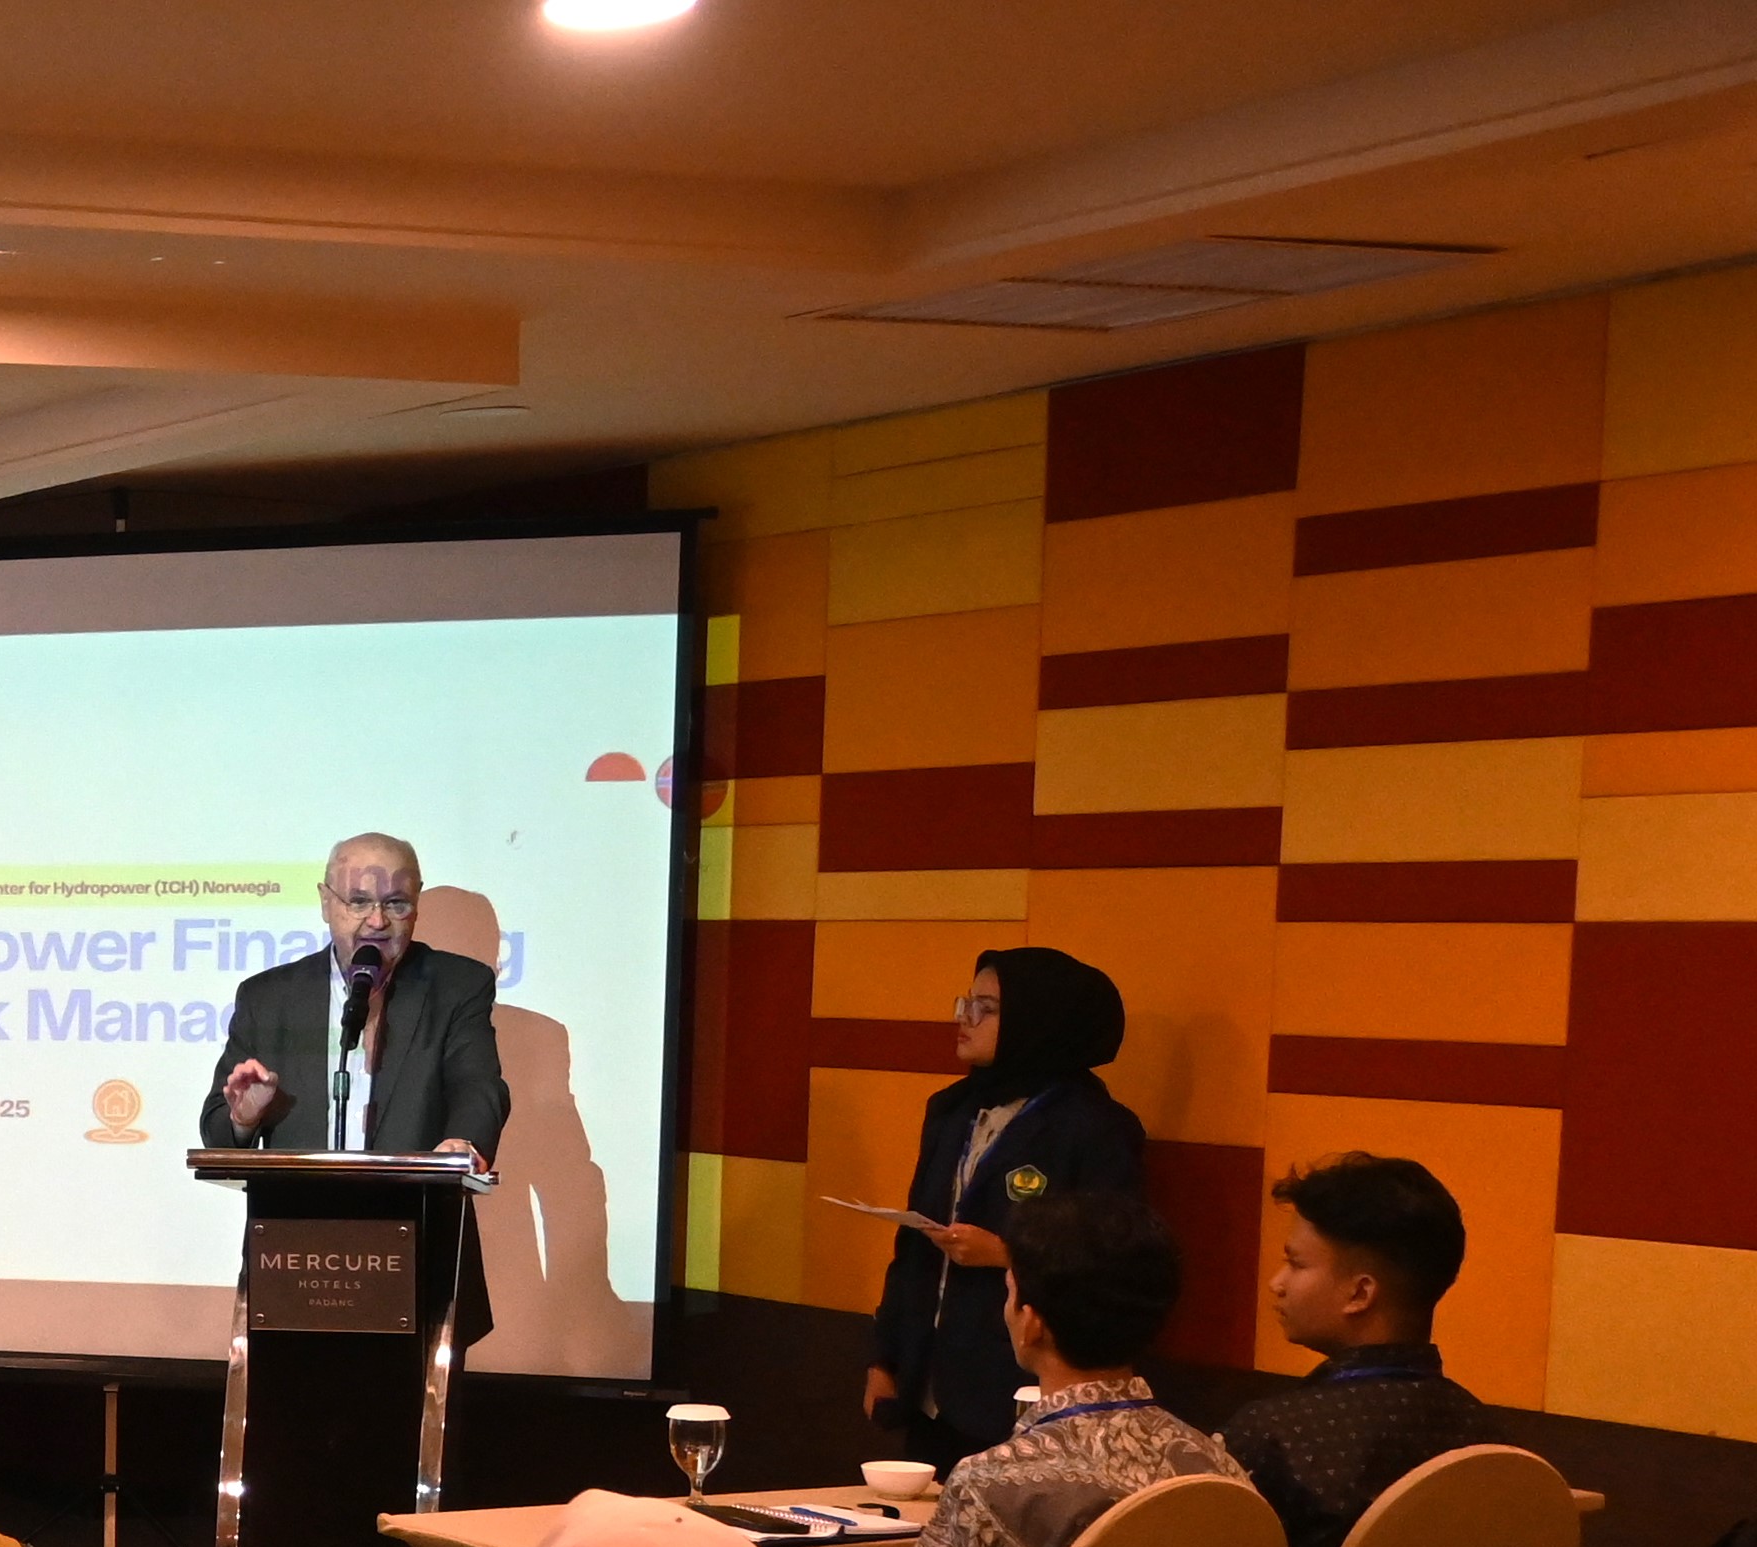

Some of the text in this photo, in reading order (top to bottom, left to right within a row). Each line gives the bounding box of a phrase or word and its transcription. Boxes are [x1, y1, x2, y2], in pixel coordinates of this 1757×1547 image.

[28, 880, 52, 896] for
[53, 880, 152, 899] Hydropower
[154, 879, 199, 897] (ICH)
[203, 880, 281, 898] Norwegia
[260, 1252, 402, 1272] MERCURE
[298, 1279, 362, 1290] HOTELS
